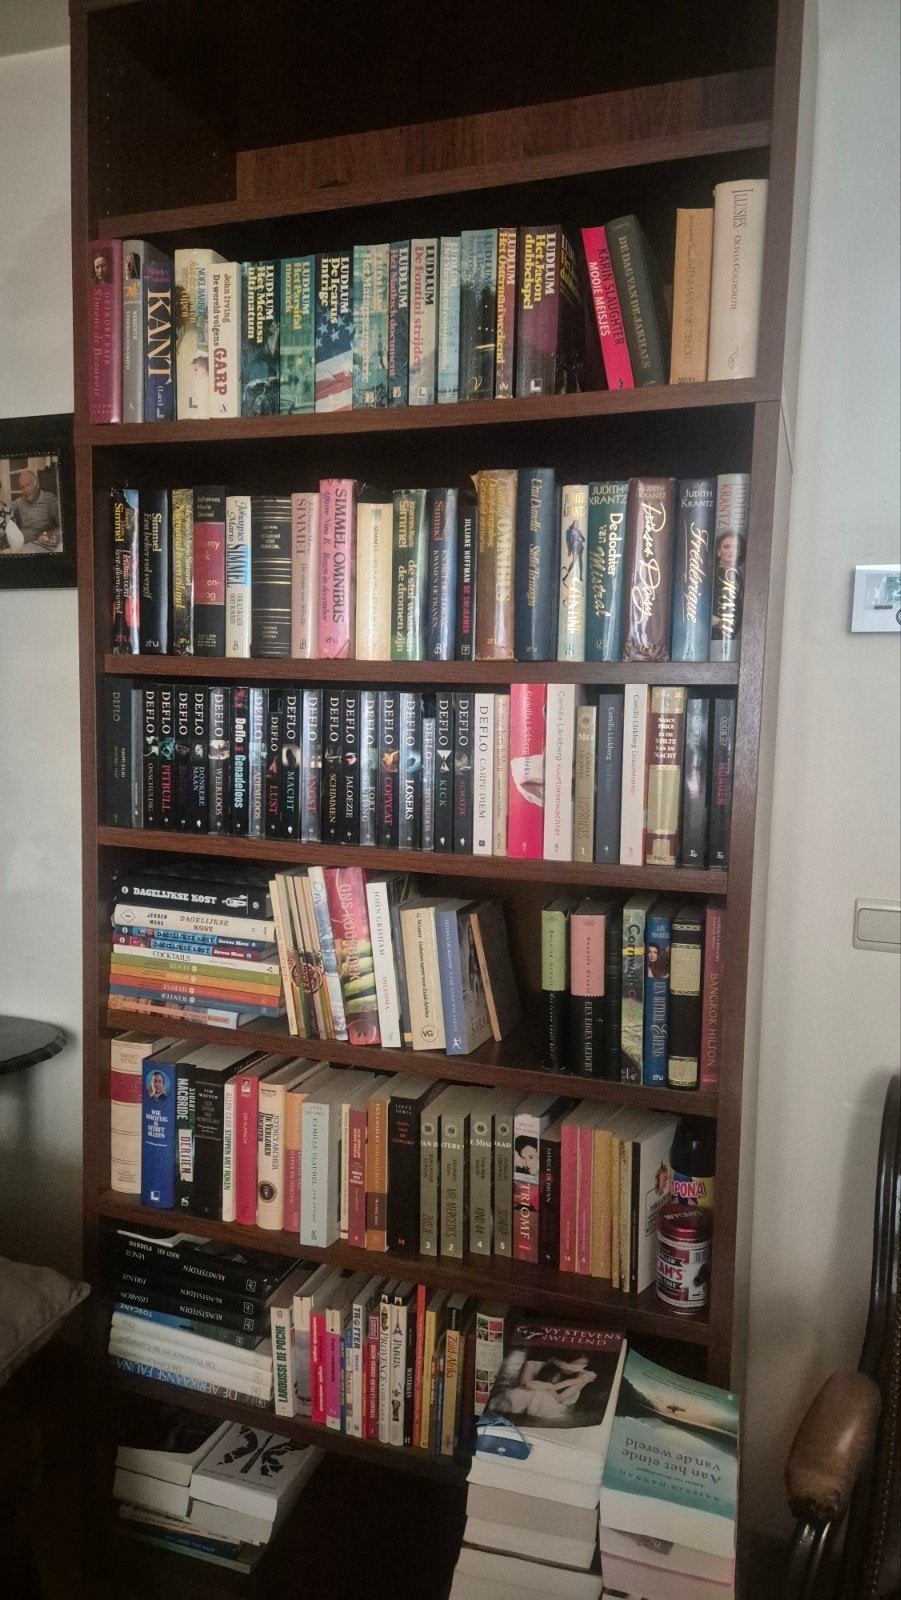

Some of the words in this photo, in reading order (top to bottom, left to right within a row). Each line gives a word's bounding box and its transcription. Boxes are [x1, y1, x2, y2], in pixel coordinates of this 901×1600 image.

[389, 249, 398, 272] Het
[485, 233, 493, 289] LUDLUM
[507, 233, 516, 285] LUDLUM
[535, 234, 545, 257] Het
[545, 233, 556, 295] LUDLUM
[598, 248, 610, 282] KARIN
[213, 275, 220, 286] De
[223, 274, 231, 294] John
[257, 266, 265, 291] Het
[294, 262, 302, 287] Het
[320, 258, 331, 307] intrige
[331, 257, 340, 277] De
[341, 256, 350, 313] LUDLUM
[398, 246, 408, 308] LUDLUM
[426, 245, 434, 305] LUDLUM
[521, 234, 534, 310] dubbelspel
[534, 260, 545, 302] Jason
[588, 262, 602, 294] MOOIE
[248, 267, 257, 339] ultimatum
[266, 264, 275, 320] LUDLUM
[302, 261, 310, 315] LUDLUM
[389, 273, 398, 318] Matlock
[222, 296, 231, 322] Irving
[257, 293, 265, 343] Medusa
[293, 288, 302, 330] Parsifal
[594, 297, 611, 337] MEISJES
[603, 284, 624, 346] SLAUGHTER
[147, 288, 172, 384] KANT
[211, 313, 220, 346] volgens
[389, 321, 398, 377] document
[213, 347, 227, 396] GARP
[590, 495, 626, 504] KRANTZ
[592, 485, 624, 494] JUDITH
[681, 499, 714, 508] KRANTZ
[685, 488, 713, 498] JUDITH
[717, 484, 733, 526] KRANTZ
[115, 503, 124, 542] Simmel
[144, 513, 152, 531] Een
[152, 513, 162, 551] Simmel
[228, 511, 237, 542] Mario
[235, 502, 248, 542] Johannes
[334, 488, 347, 549] SIMMEL
[399, 499, 409, 549] Simmel
[434, 500, 444, 542] Simmel
[598, 525, 607, 544] van
[610, 513, 623, 531] De
[641, 502, 666, 558] Prinses
[144, 533, 152, 557] beker
[607, 532, 622, 576] dochter
[144, 559, 152, 573] vol
[227, 544, 248, 588] SIMMEL
[398, 565, 407, 581] de
[591, 546, 611, 617] Mistral
[685, 522, 709, 624] Frédérique
[142, 574, 152, 598] vergif
[333, 552, 346, 623] OMNIBUS
[632, 559, 661, 624] Daisy
[397, 583, 406, 630] dromen
[396, 631, 406, 653] zijn
[146, 690, 155, 734] DEFLO
[162, 691, 171, 734] DEFLO
[179, 692, 188, 736] DEFLO
[195, 692, 204, 736] DEFLO
[215, 693, 224, 738] DEFLO
[235, 717, 246, 744] Deflo
[254, 696, 263, 740] DEFLO
[287, 695, 297, 740] DEFLO
[308, 697, 318, 742] DEFLO
[329, 697, 339, 742] DEFLO
[346, 699, 356, 744] DEFLO
[365, 700, 375, 745] DEFLO
[384, 699, 394, 745] DEFLO
[406, 700, 416, 747] DEFLO
[439, 699, 449, 746] DEFLO
[479, 705, 489, 752] DEFLO
[271, 716, 279, 752] DEFLO
[162, 764, 171, 813] PITBULL
[215, 768, 223, 817] WEERLOOS
[234, 754, 247, 809] Genadeloos
[287, 770, 295, 812] MACHT
[307, 772, 317, 814] ANGST
[439, 779, 447, 808] KICK
[478, 757, 487, 791] CARPE
[270, 785, 278, 816] LUST
[346, 775, 354, 819] JALOEZIE
[384, 776, 392, 827] COPYCAT
[405, 779, 413, 820] LOSERS
[478, 793, 486, 819] DIEM
[133, 887, 190, 901] DAGELIJKSE
[191, 894, 217, 905] KOST
[339, 884, 355, 910] ONS
[373, 891, 384, 914] JOHN
[180, 915, 230, 927] DAGELIJKSE
[376, 916, 387, 956] GRISHAM
[153, 950, 191, 962] COCKTAILS
[161, 993, 189, 1002] WINTER
[708, 973, 721, 1025] BANGKOK
[706, 1029, 718, 1067] HILTON
[177, 1078, 190, 1120] MACBRIDE
[188, 1088, 196, 1112] STUART
[265, 1112, 273, 1122] DE
[264, 1123, 273, 1157] VERLOREN
[272, 1113, 280, 1141] JEFFREY
[181, 1137, 194, 1175] DERTIEN
[272, 1143, 280, 1171] ARCHER
[545, 1147, 553, 1172] PATRICK
[546, 1174, 552, 1182] DE
[520, 1184, 531, 1239] TRIOMF
[183, 1265, 226, 1282] KUNSTSTEDEN
[120, 1302, 153, 1318] TOSCANE
[276, 1325, 287, 1348] POCHE
[277, 1350, 287, 1362] DE
[393, 1340, 402, 1368] PARIJS
[117, 1357, 152, 1376] FAUNA
[446, 1336, 457, 1378] Zuid-Afrika
[155, 1366, 217, 1394] AFRIKAANSE
[219, 1386, 239, 1401] DE
[277, 1364, 288, 1403] LAROUSSE
[622, 1449, 659, 1468] einde
[626, 1438, 672, 1459] wereld
[675, 1454, 692, 1464] de
[695, 1458, 720, 1471] van
[665, 1462, 685, 1476] het
[691, 1469, 721, 1484] Aan
